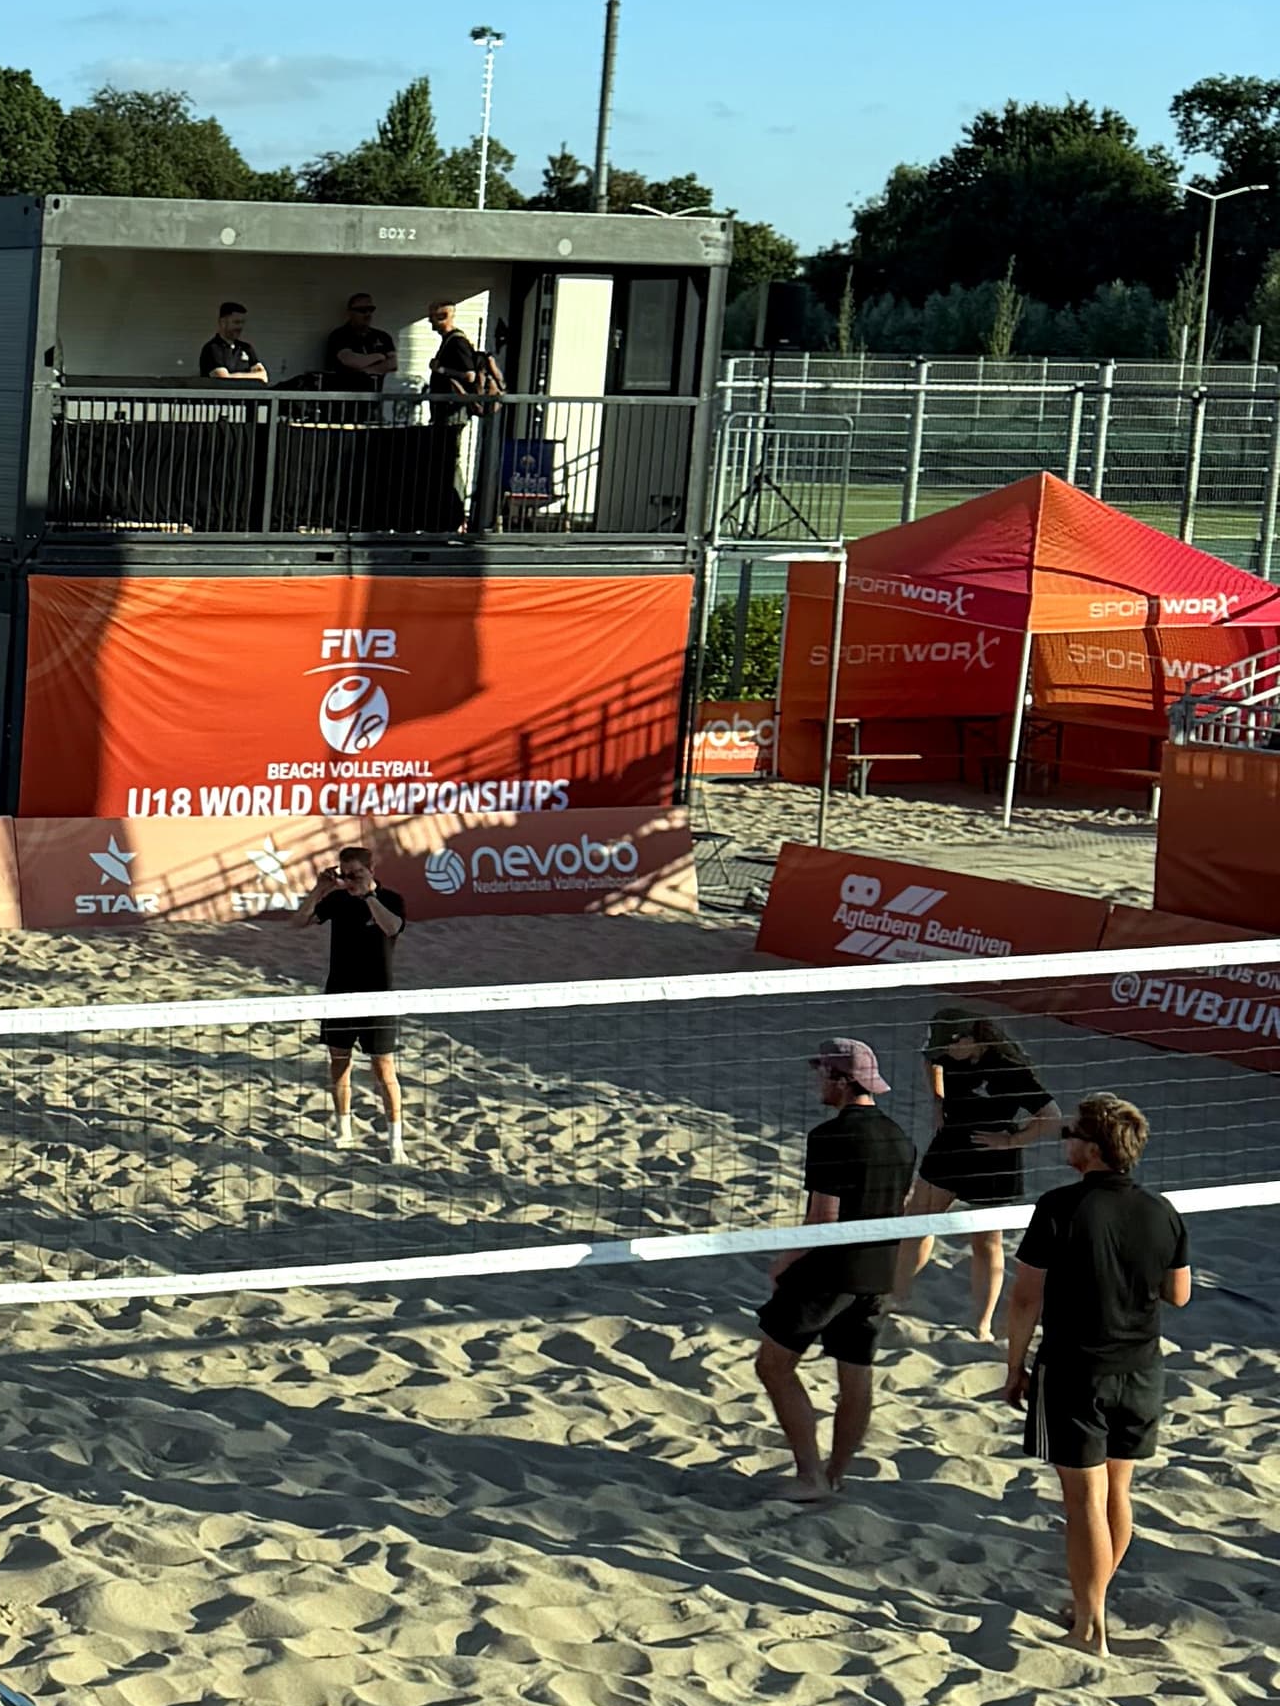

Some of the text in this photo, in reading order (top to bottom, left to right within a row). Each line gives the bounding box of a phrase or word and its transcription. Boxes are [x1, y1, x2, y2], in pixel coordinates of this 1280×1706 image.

[379, 227, 417, 240] BOX 2
[844, 574, 975, 616] PORTWORX
[320, 628, 397, 659] FIVB
[267, 760, 433, 780] BEACH VOLLEYBALL
[126, 779, 570, 817] U18 WORLD CHAMPIONSHIPS
[471, 833, 639, 878] nevobo
[75, 893, 160, 914] STAR
[832, 903, 1013, 957] Agterberg Bedrijven
